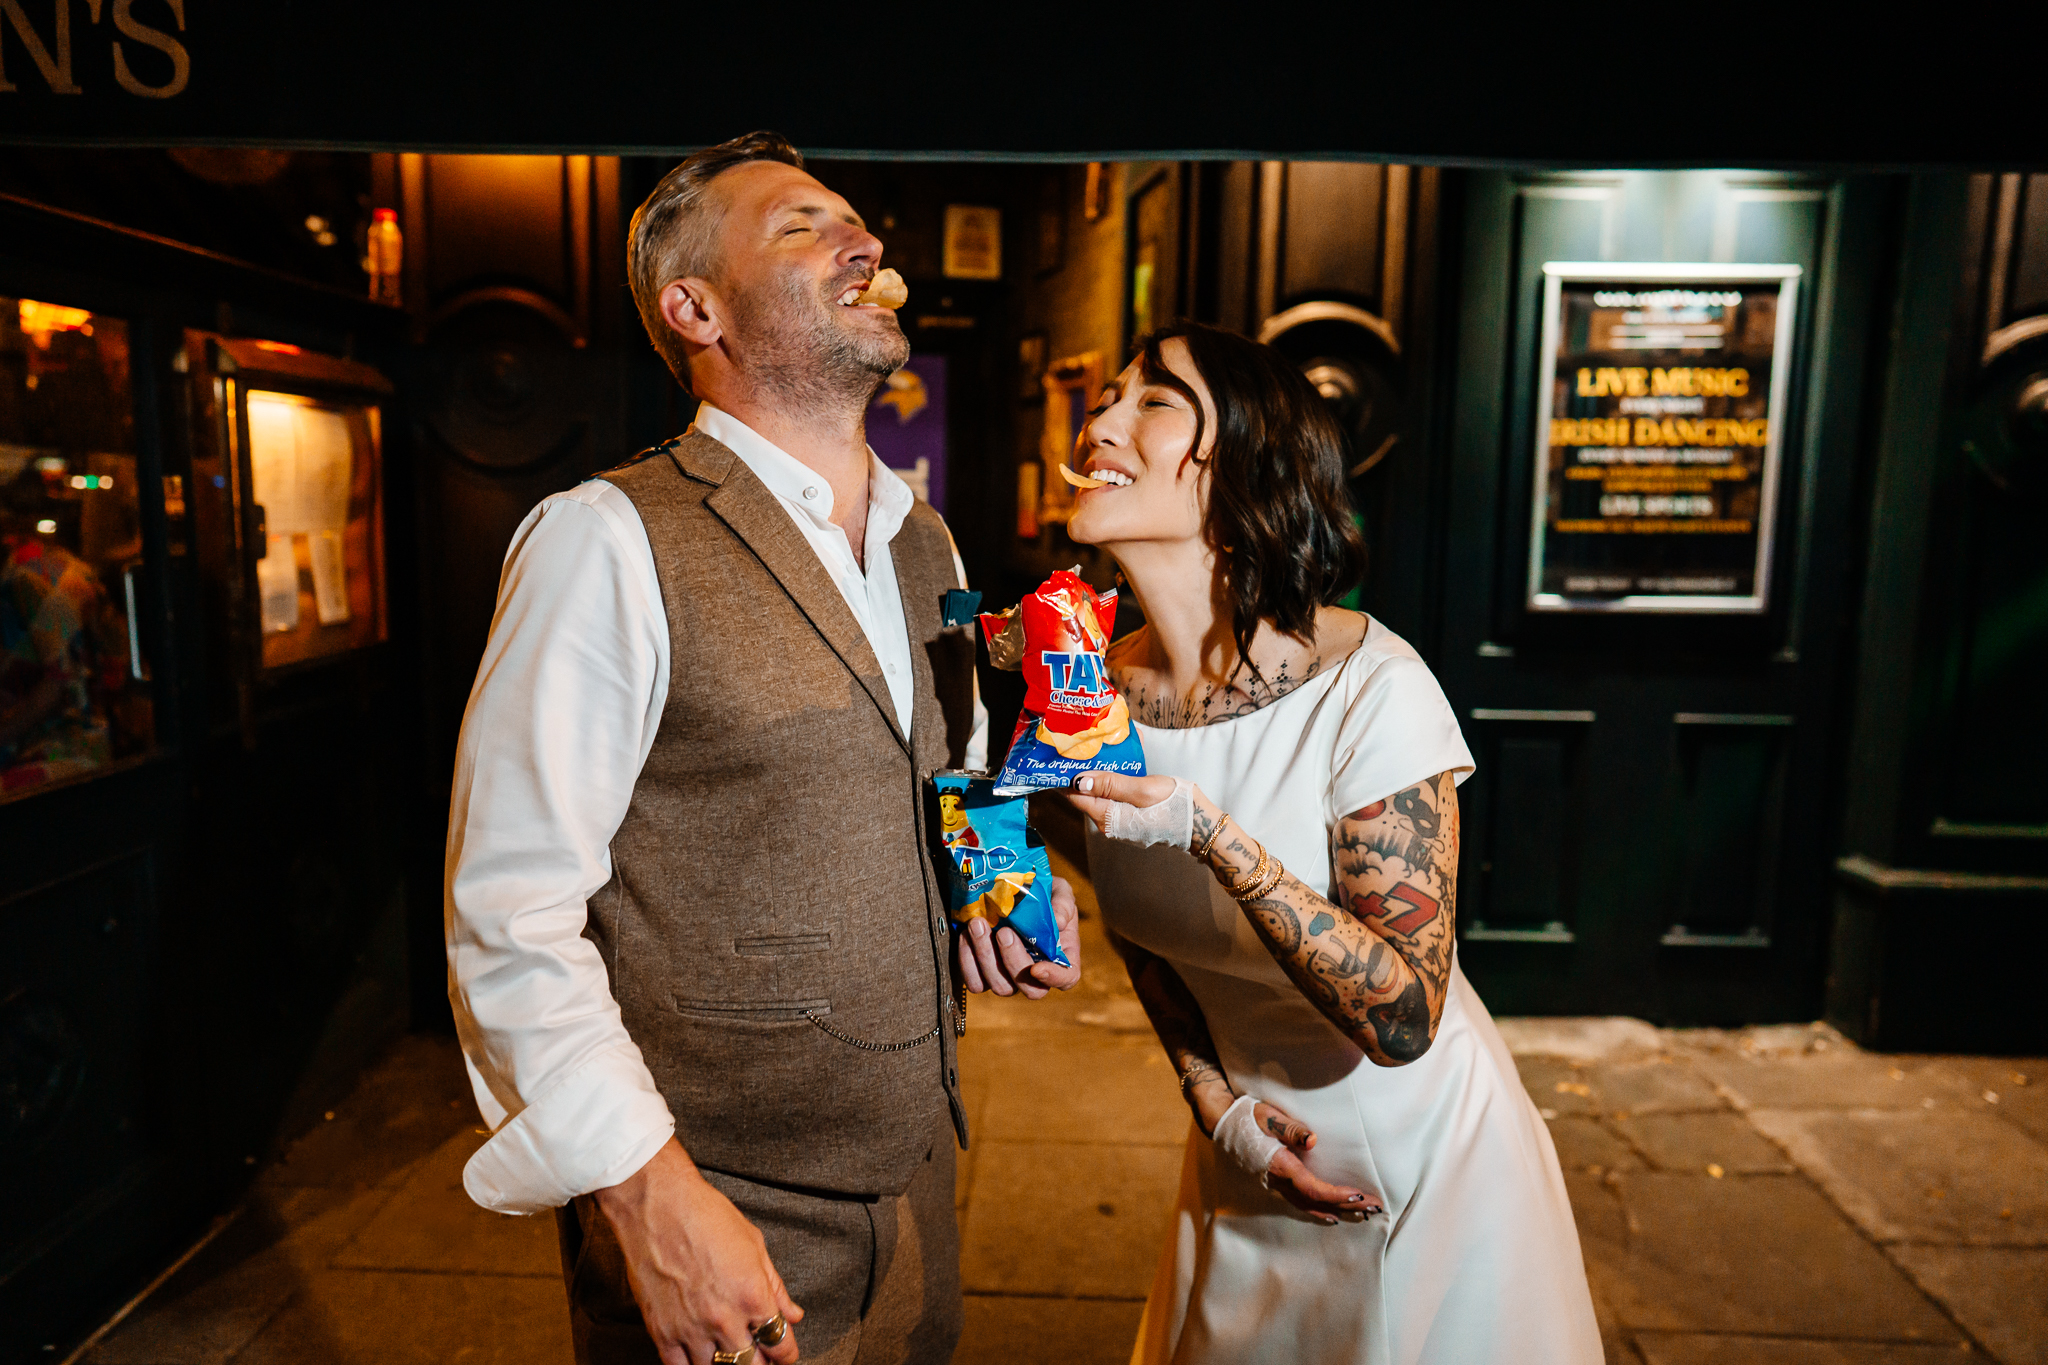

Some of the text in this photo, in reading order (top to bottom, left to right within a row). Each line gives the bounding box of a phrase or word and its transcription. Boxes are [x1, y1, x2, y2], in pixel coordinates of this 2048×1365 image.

[1577, 367, 1750, 397] LIVE MUSIC
[1548, 418, 1772, 446] IRISH DANCING
[1050, 691, 1092, 707] Cheese
[1026, 758, 1046, 768] The
[1093, 760, 1119, 771] Irish
[1121, 760, 1142, 774] Crisp
